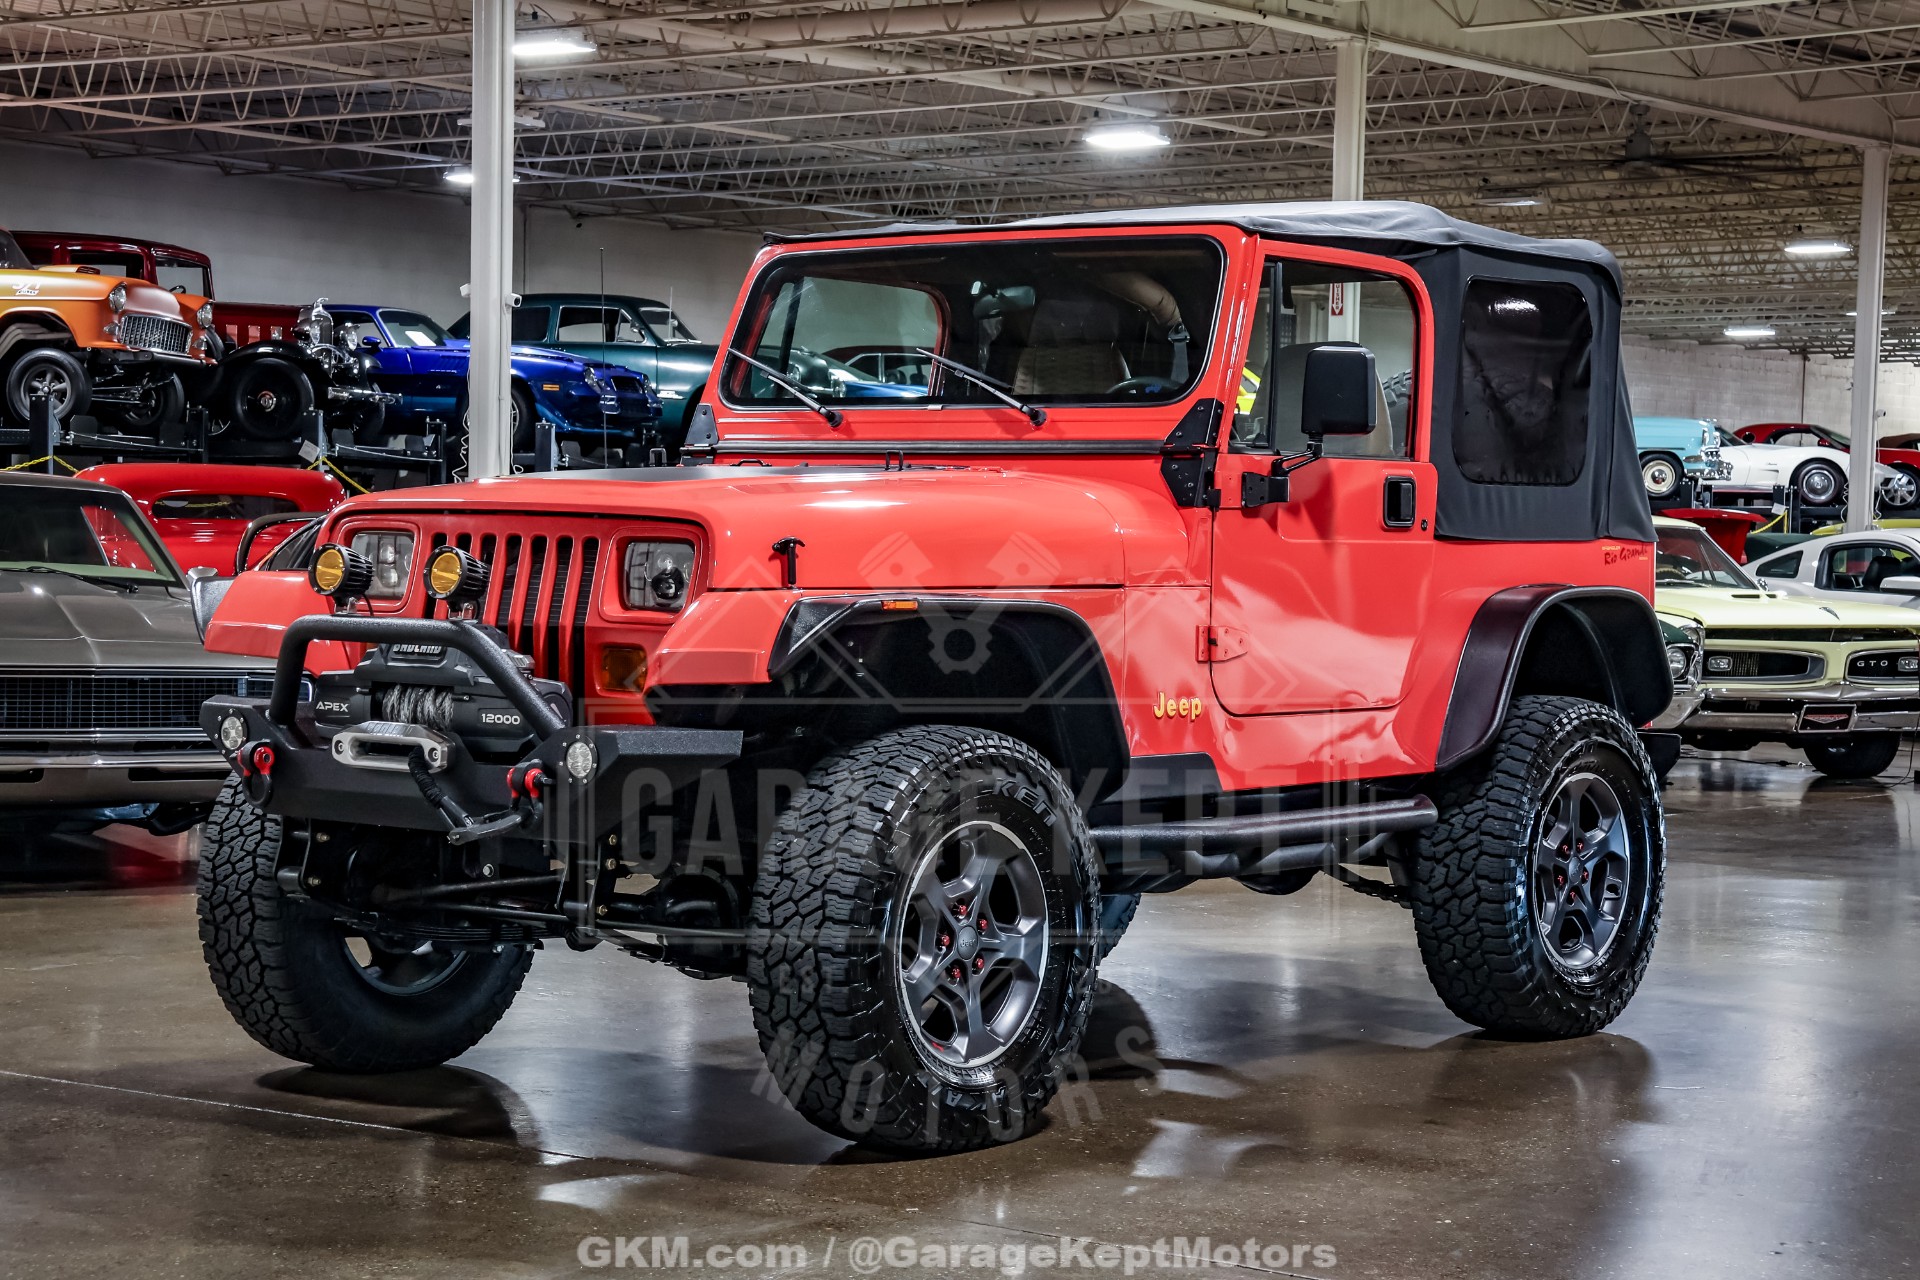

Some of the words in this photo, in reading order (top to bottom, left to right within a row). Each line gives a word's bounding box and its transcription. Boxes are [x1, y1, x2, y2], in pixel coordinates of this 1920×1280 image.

[1604, 551, 1618, 566] Rio
[315, 701, 349, 713] APEX
[1153, 692, 1202, 720] Jeep
[481, 713, 521, 725] 12000
